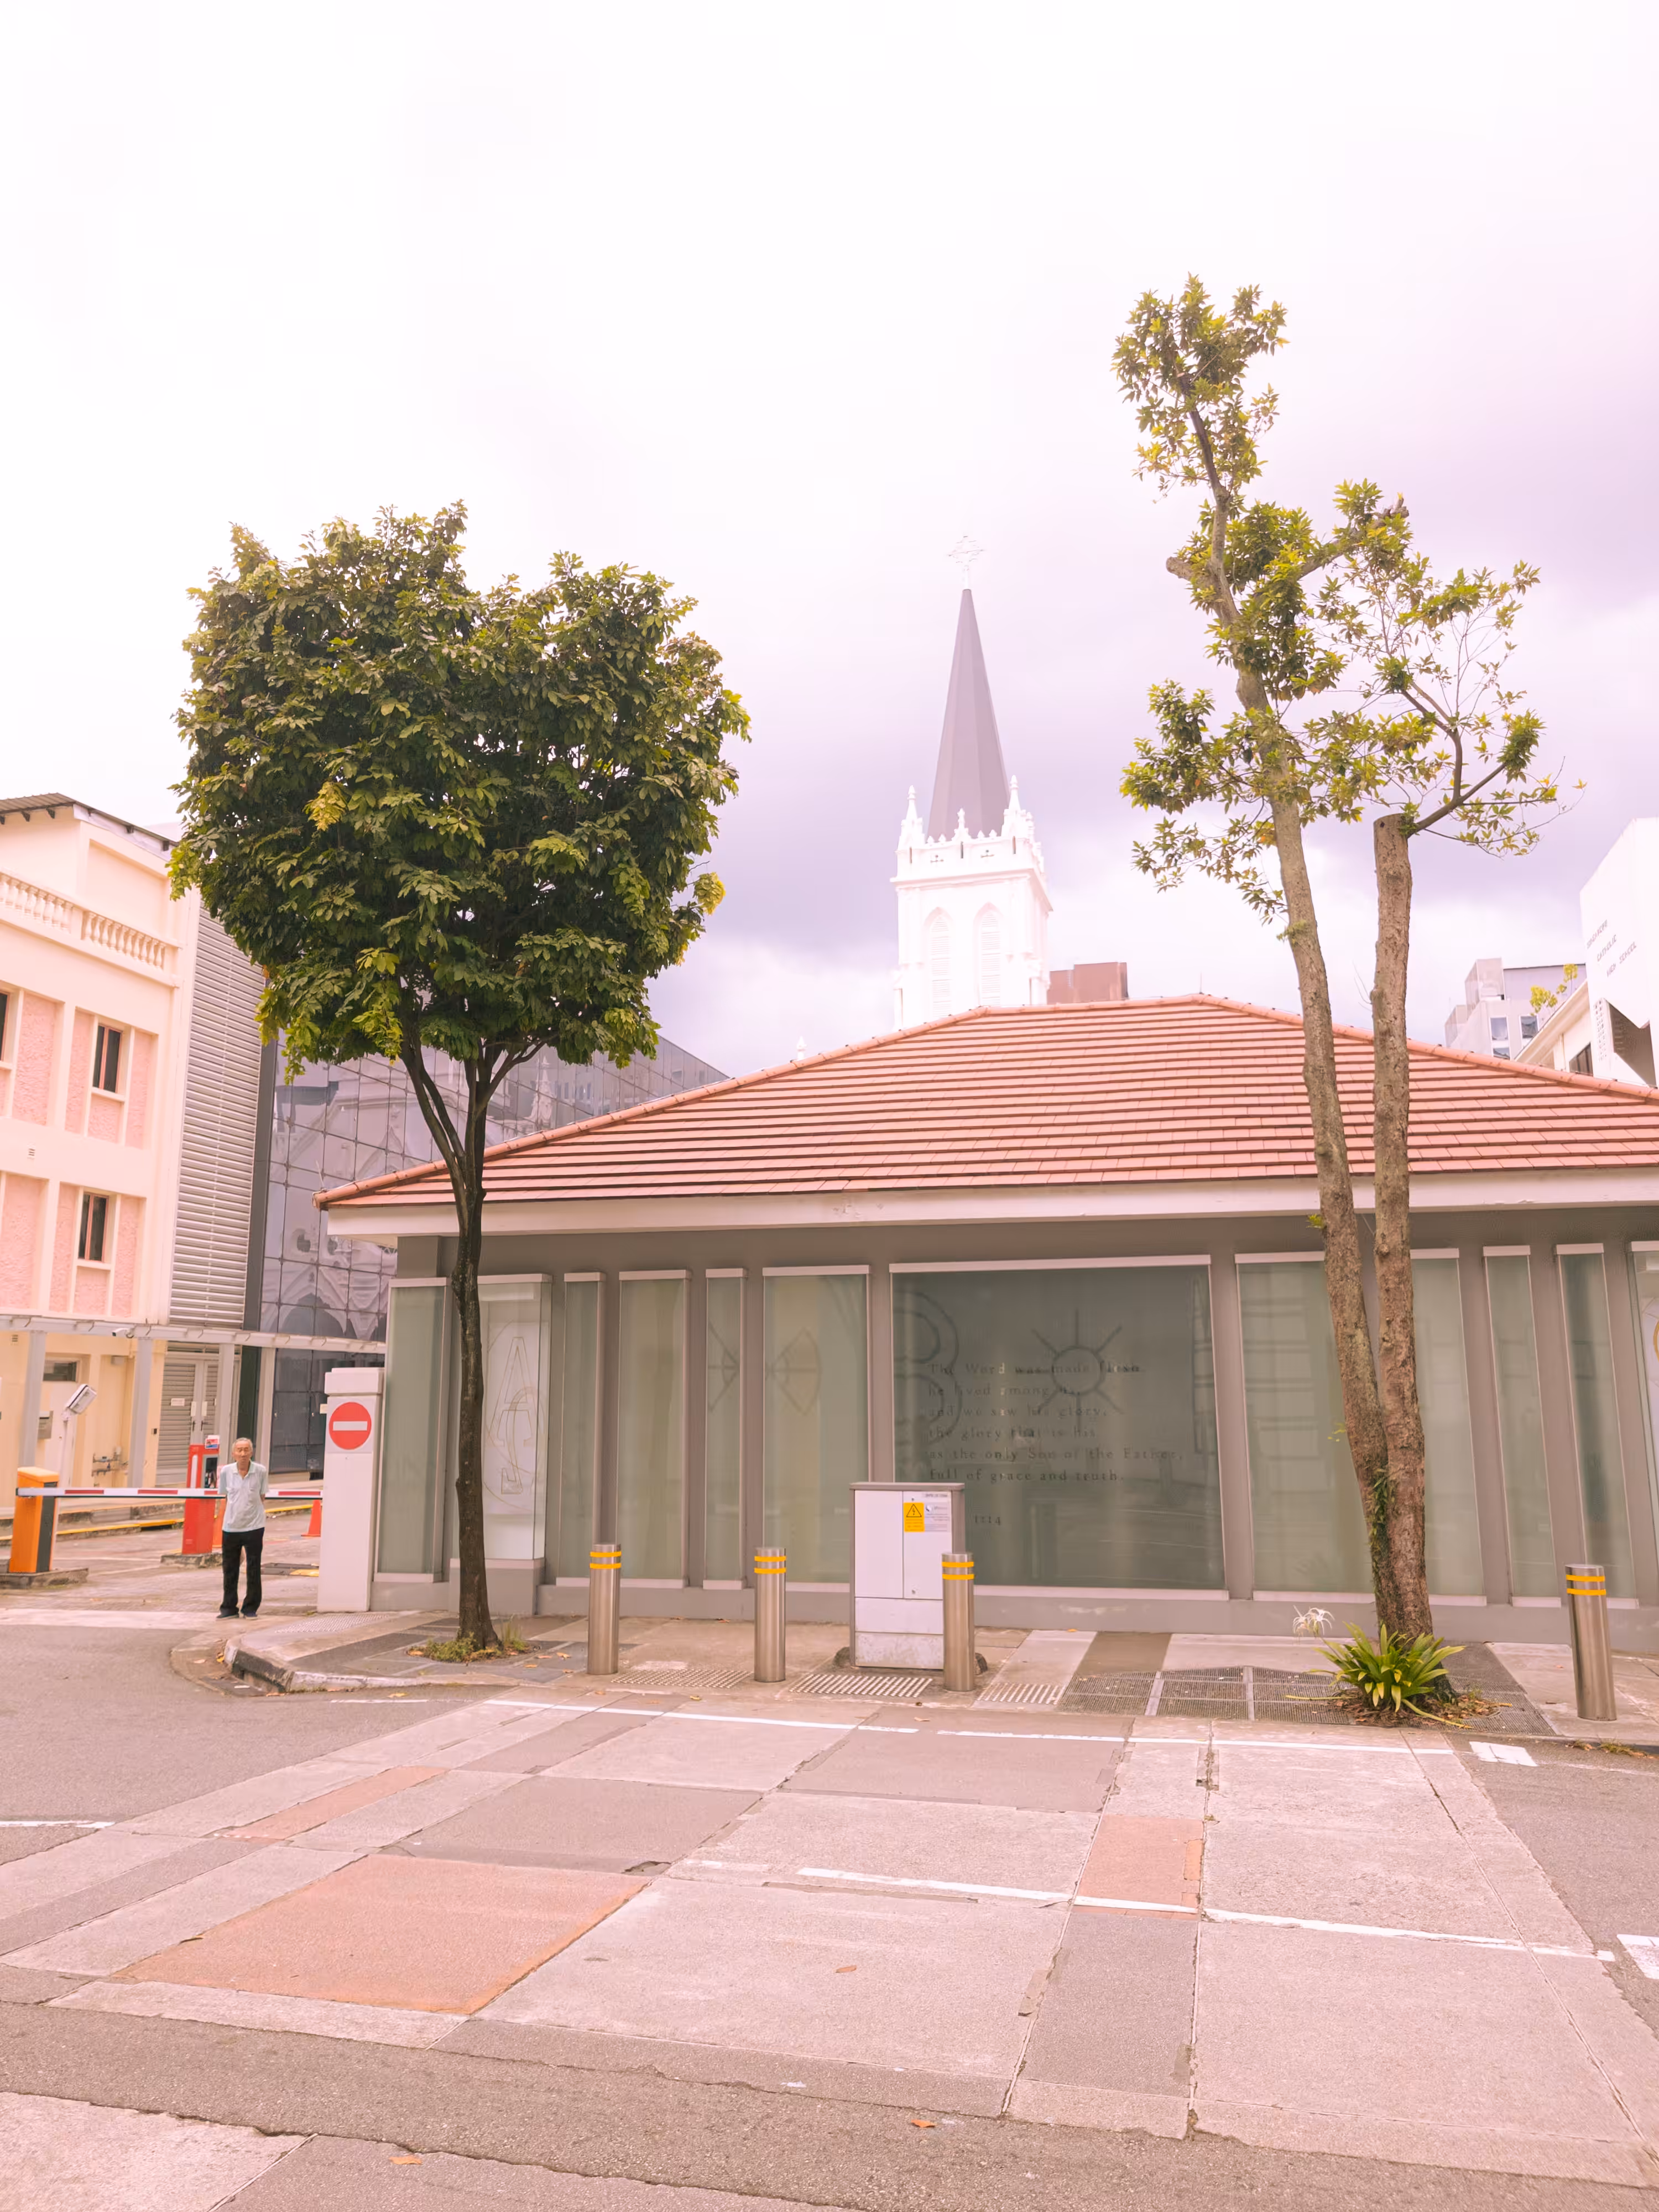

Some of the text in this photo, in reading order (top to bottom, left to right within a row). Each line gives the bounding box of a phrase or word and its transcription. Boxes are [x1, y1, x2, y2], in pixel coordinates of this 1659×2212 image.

[966, 1362, 1005, 1374] Word
[961, 1427, 1001, 1442] glory
[953, 1447, 975, 1459] the
[985, 1447, 1019, 1463] only
[1027, 1447, 1057, 1459] Son
[1089, 1446, 1114, 1459] the
[930, 1468, 1124, 1484] full of grace and truth.
